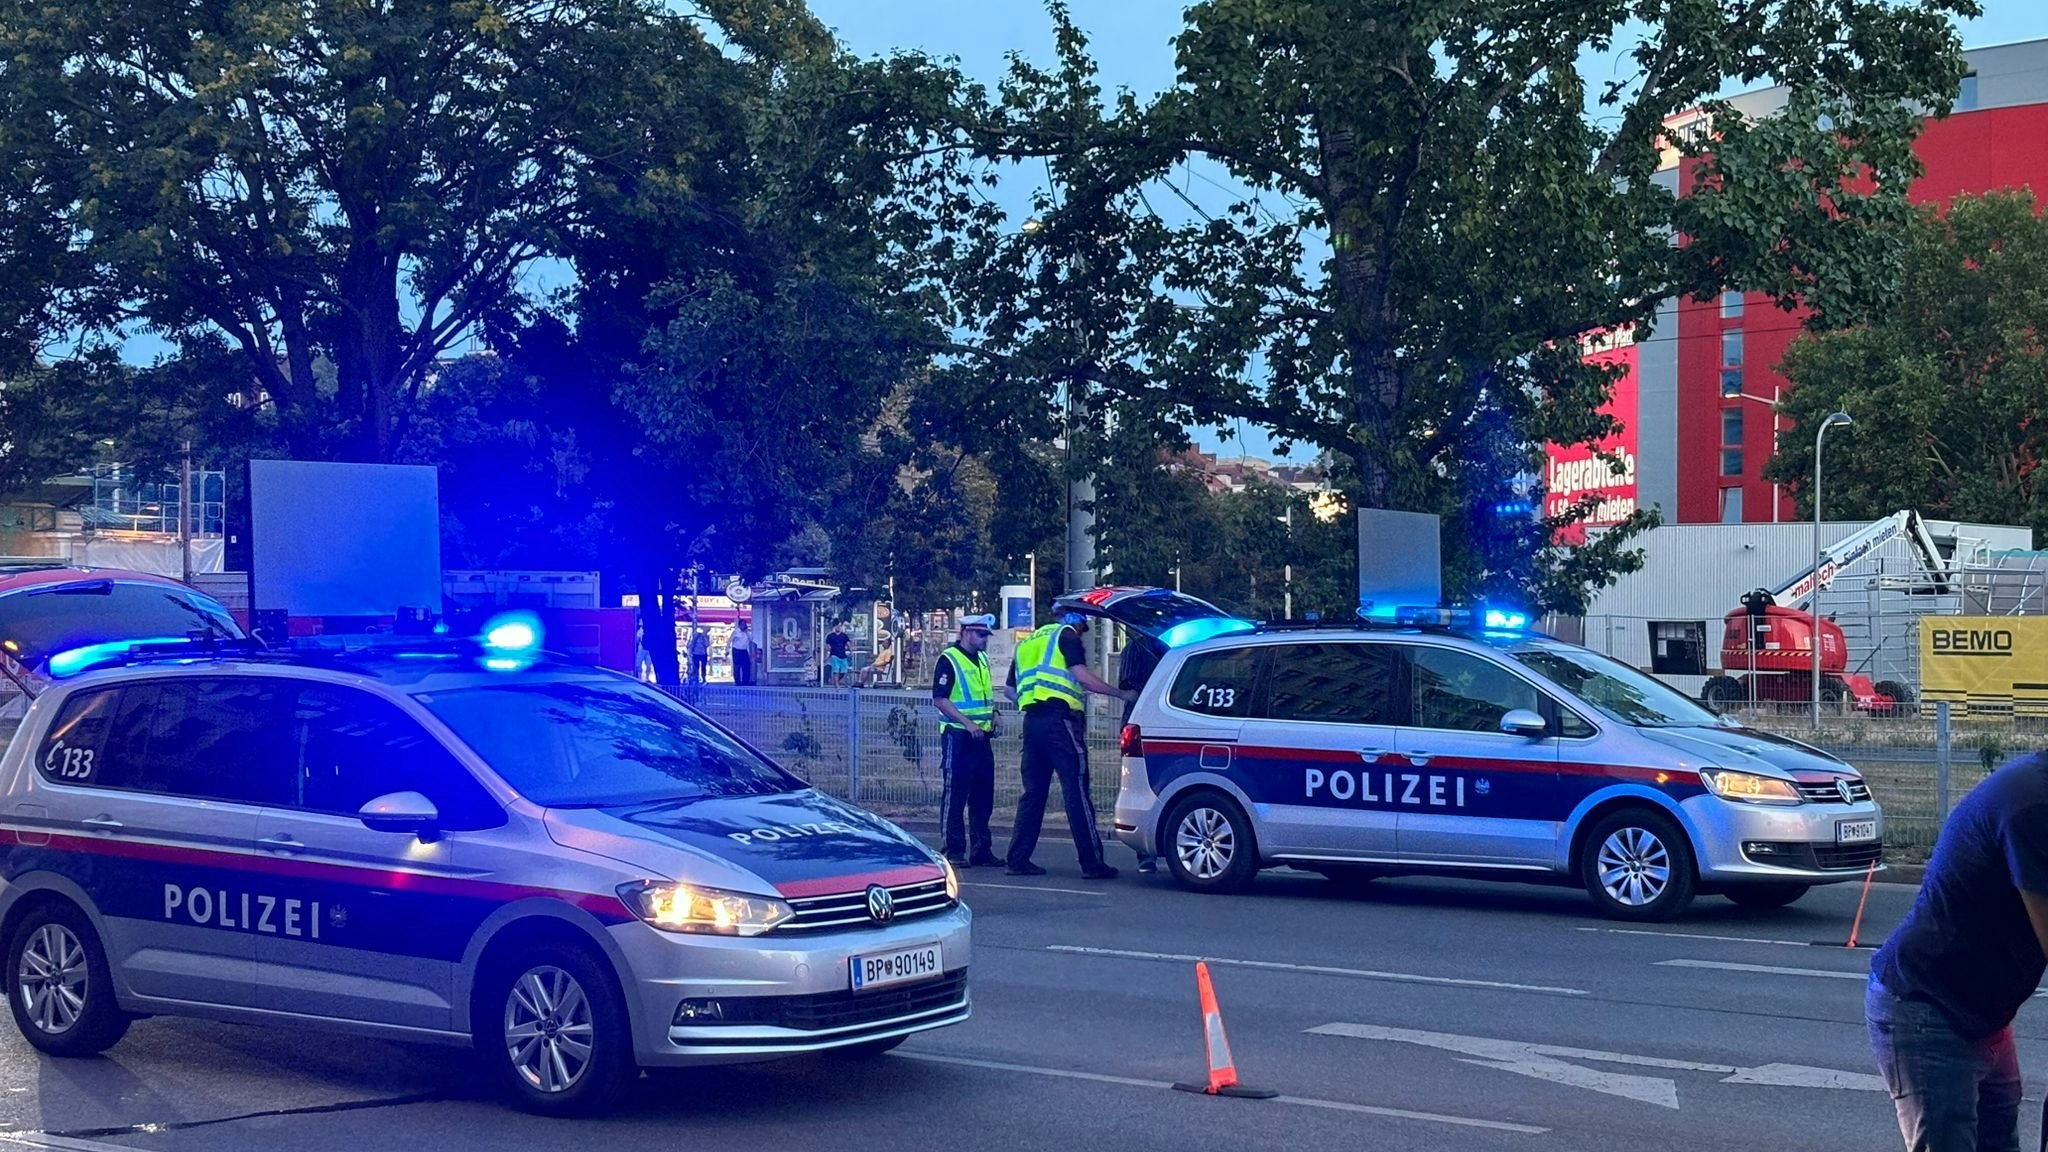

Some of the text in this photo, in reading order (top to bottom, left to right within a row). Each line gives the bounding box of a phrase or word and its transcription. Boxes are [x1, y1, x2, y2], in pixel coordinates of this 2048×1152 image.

[1872, 524, 1896, 546] mieten
[1932, 629, 2012, 651] BEMO
[1207, 688, 1235, 708] 133
[61, 748, 94, 778] 133
[1305, 768, 1465, 807] POLIZEI
[727, 822, 862, 845] POLIZEI
[165, 883, 319, 938] POLIZEI
[866, 949, 935, 982] BP 90149
